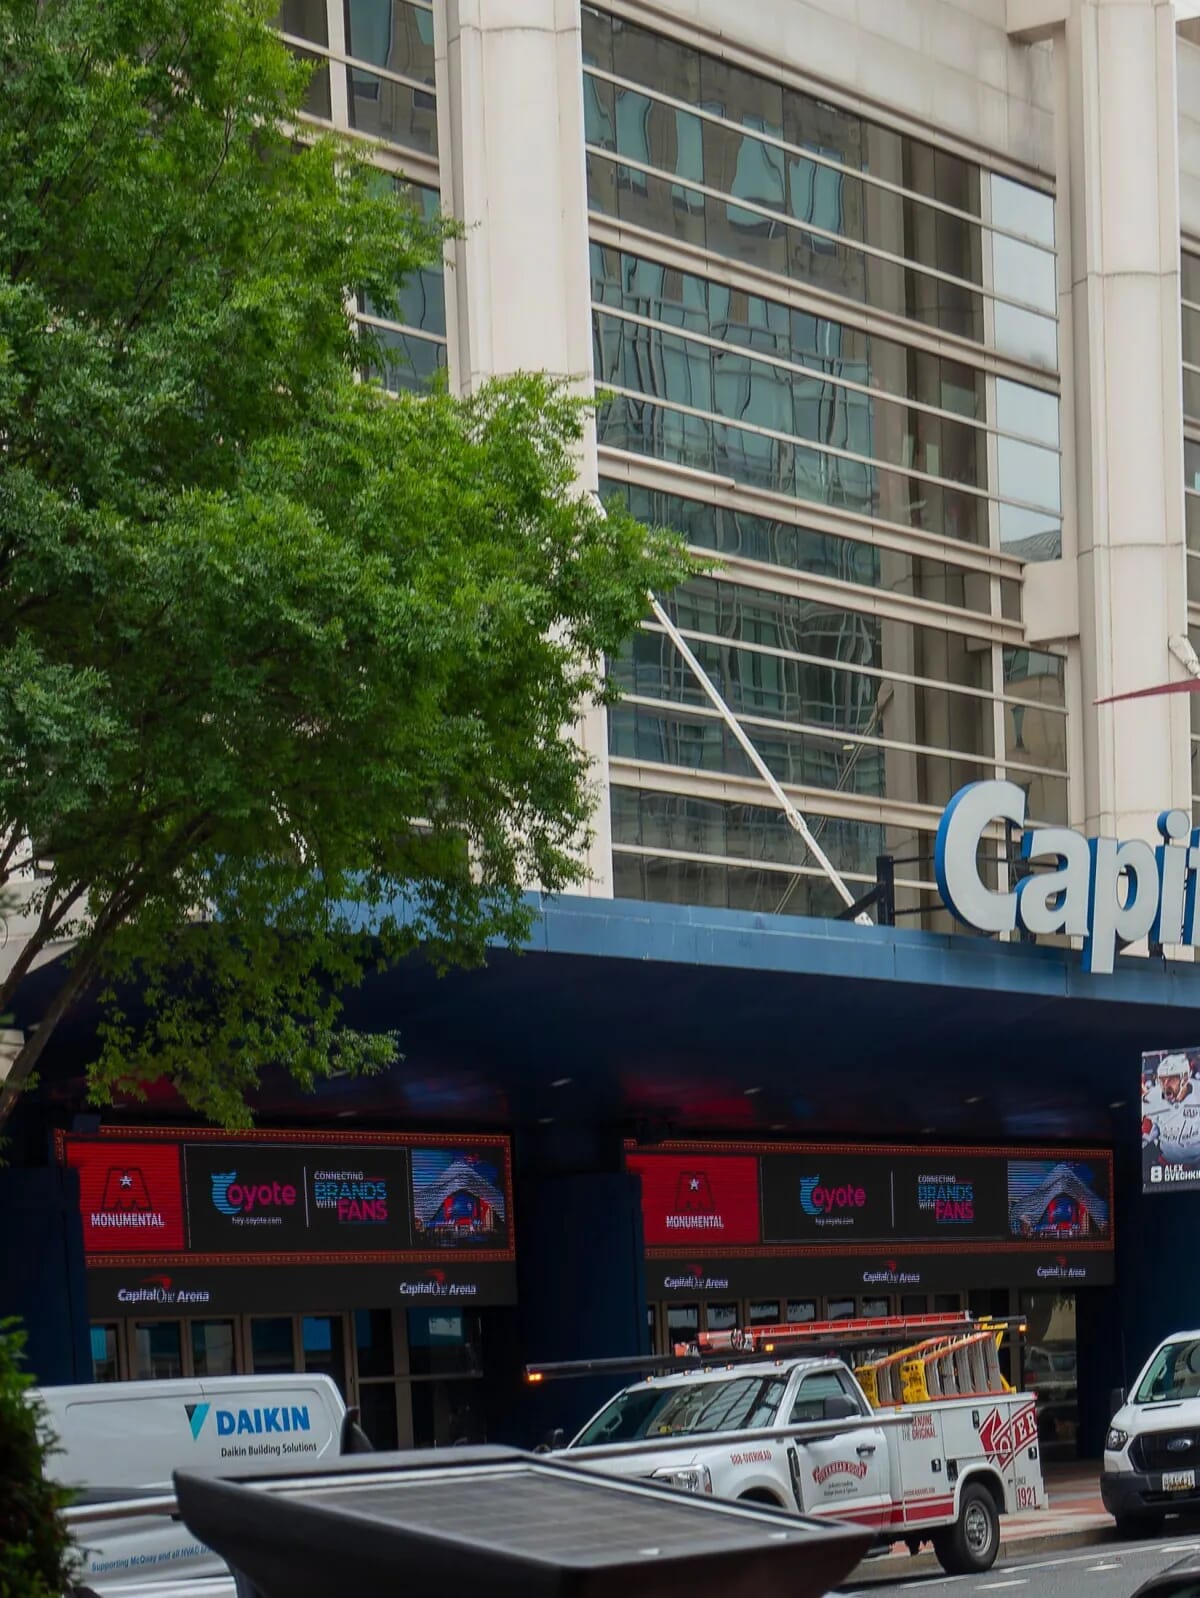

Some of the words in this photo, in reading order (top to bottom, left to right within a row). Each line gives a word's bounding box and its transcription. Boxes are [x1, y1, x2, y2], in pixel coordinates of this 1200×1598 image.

[313, 1170, 364, 1181] CONNECTING
[1151, 1165, 1162, 1182] 8
[314, 1181, 388, 1200] BRANDS
[917, 1183, 974, 1201] BRANDS
[338, 1199, 389, 1221] FANS
[935, 1200, 974, 1220] FANS
[91, 1212, 166, 1228] MONUMENTAL
[665, 1215, 725, 1230] MONUMENTAL
[117, 1288, 157, 1304] Capital
[176, 1290, 210, 1303] Arena
[448, 1283, 477, 1295] Arena
[215, 1405, 311, 1436] DAIKIN
[220, 1447, 247, 1458] Daikin
[248, 1443, 281, 1457] Building
[282, 1441, 317, 1454] Solutions
[1017, 1486, 1037, 1509] 1921
[91, 1558, 129, 1574] Supporting
[130, 1553, 157, 1566] McQuay
[157, 1551, 171, 1562] and
